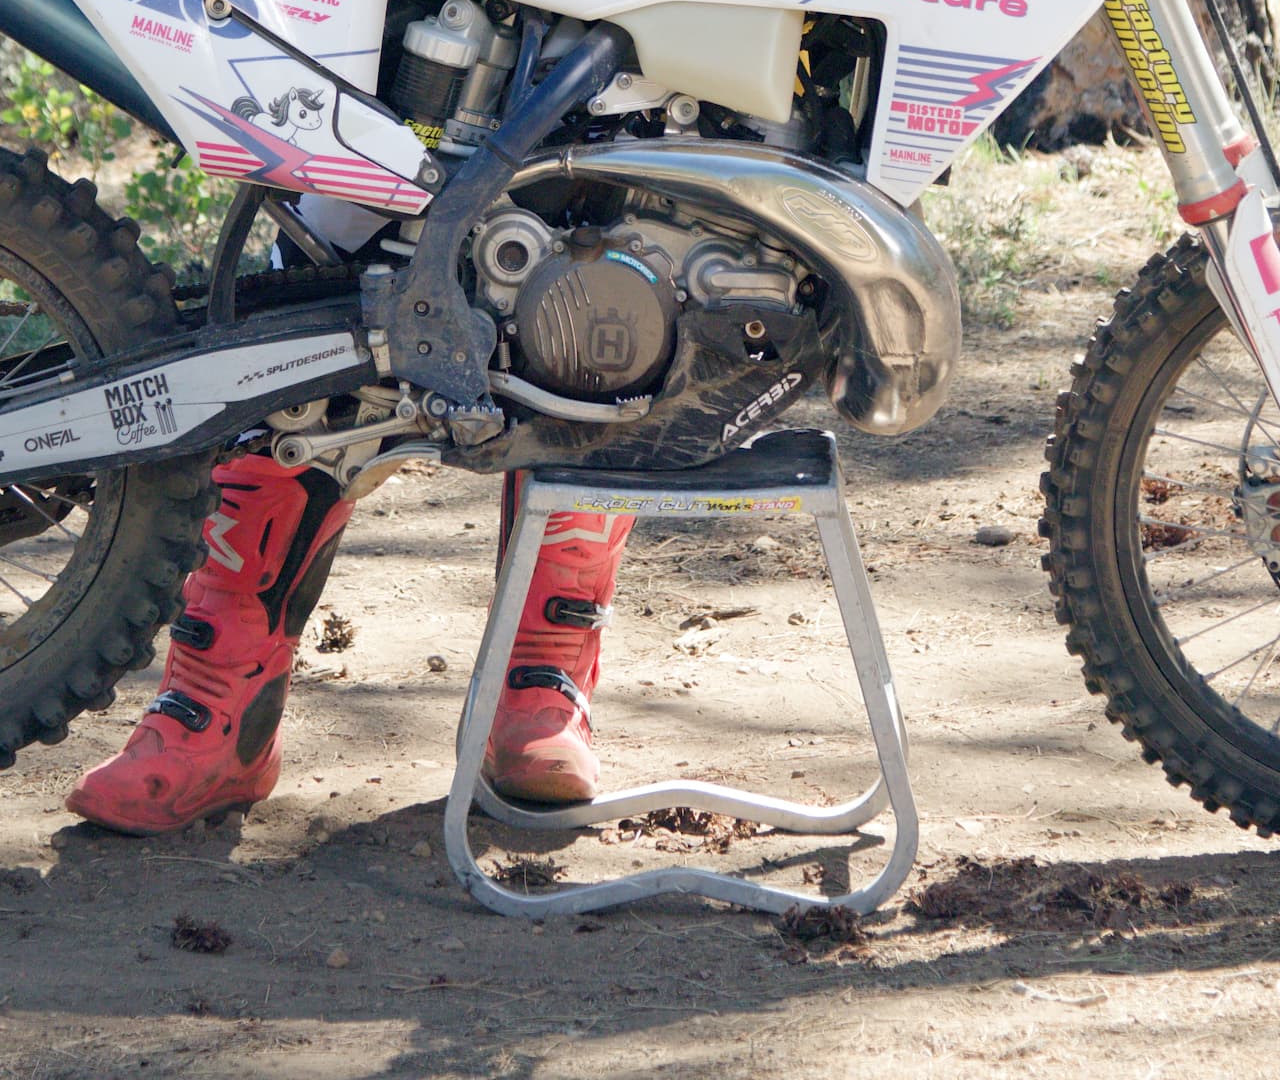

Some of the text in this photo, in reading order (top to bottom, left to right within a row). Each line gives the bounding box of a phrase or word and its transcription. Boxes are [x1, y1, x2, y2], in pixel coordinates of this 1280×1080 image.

[131, 15, 194, 48] MAINLINE
[908, 103, 962, 119] SISTERS
[907, 115, 961, 136] MOTO
[890, 149, 932, 163] MAINLINE
[266, 345, 345, 376] SPLITDESIGNS
[104, 373, 170, 409] MATCH
[109, 402, 148, 430] BOX
[116, 422, 158, 446] Coffee
